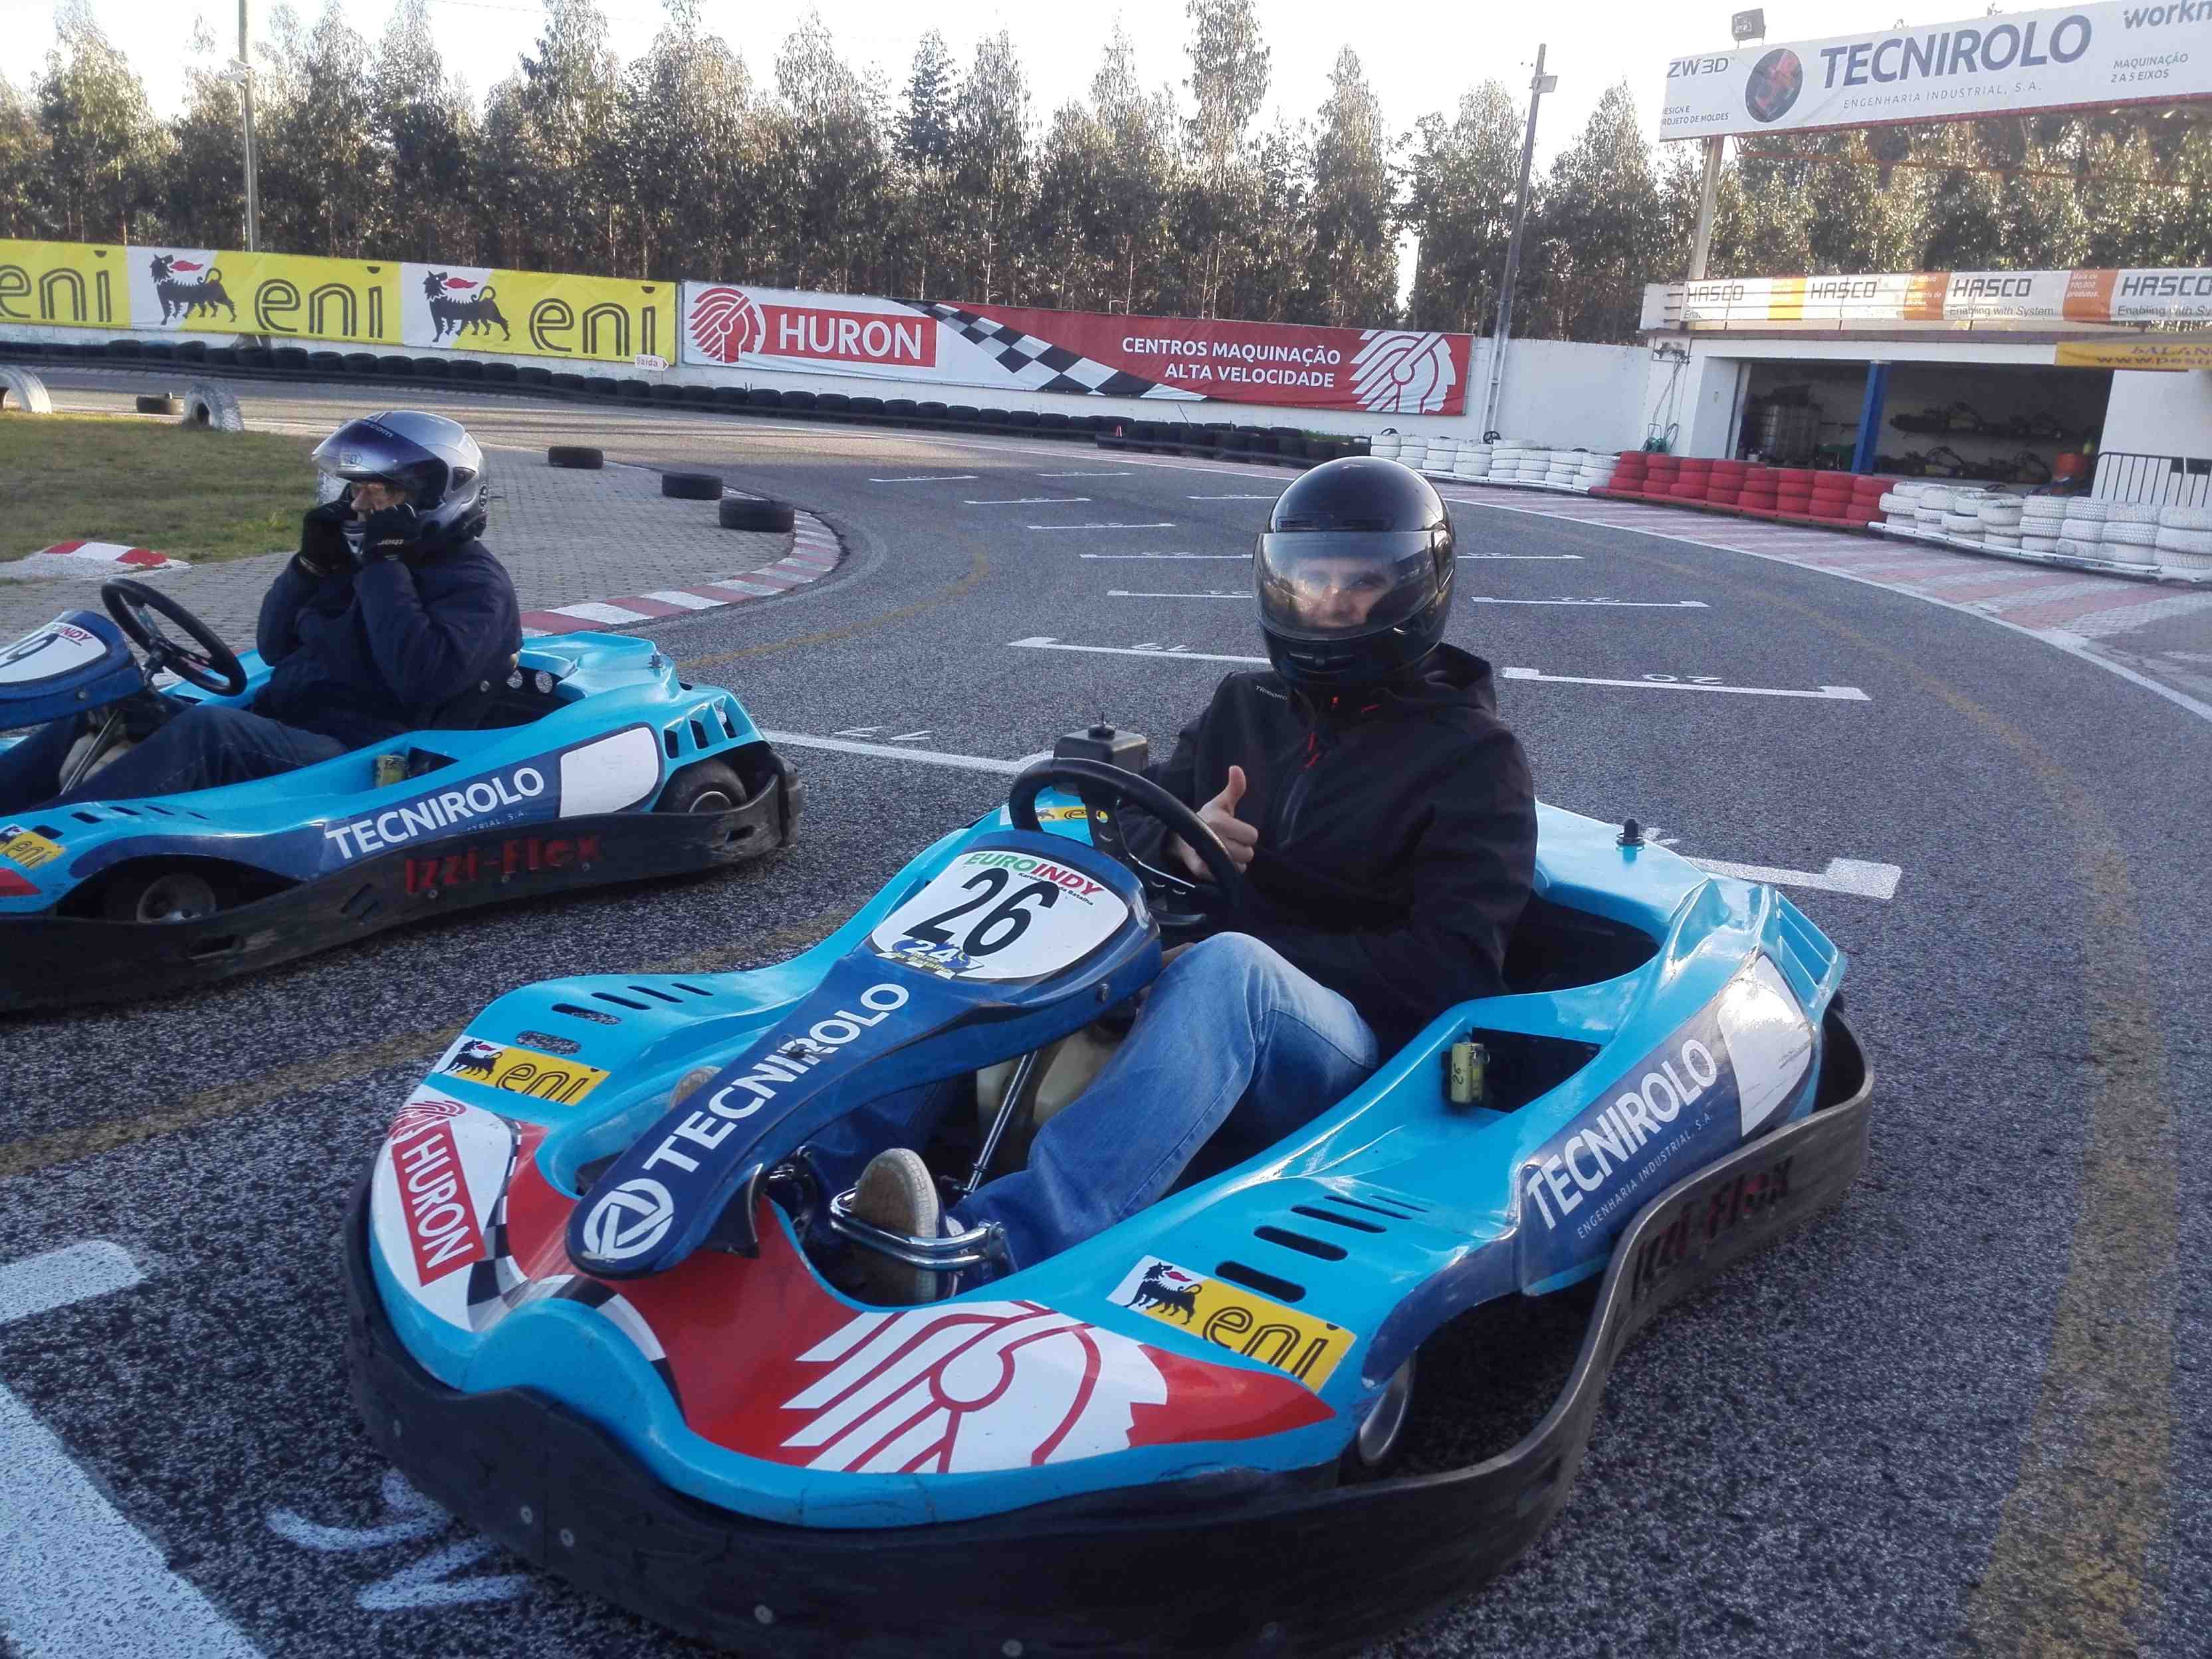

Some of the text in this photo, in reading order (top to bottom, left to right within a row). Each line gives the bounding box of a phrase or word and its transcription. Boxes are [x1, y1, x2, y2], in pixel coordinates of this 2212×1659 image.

[1820, 14, 2092, 89] TECNIROLO
[2118, 72, 2127, 82] A
[2137, 68, 2170, 80] EIXOS
[1690, 115, 1700, 124] DE
[1701, 112, 1729, 122] MOLDES
[1843, 80, 2043, 109] ENGENHARIA INDUSTRIAL, S.A.
[0, 250, 112, 323] eni
[255, 265, 384, 339] eni
[1811, 281, 1878, 299] HASCO
[1953, 278, 2033, 298] HASCO
[2120, 276, 2212, 296] HASCO
[529, 286, 656, 357] eni
[1949, 304, 1991, 316] Enabling
[1993, 306, 2013, 316] with
[2118, 304, 2166, 317] Enabling
[778, 313, 923, 360] HURON
[1122, 336, 1341, 367] CENTROS MAQUINAÇÃO
[1164, 363, 1335, 388] ALTA VELOCIDADE
[324, 767, 545, 859] TECNIROLO
[902, 867, 1061, 957] 26
[495, 1063, 600, 1103] eni
[641, 983, 910, 1173] TECNIROLO
[1526, 1039, 1717, 1230] TECNIROLO
[1577, 1111, 1714, 1240] ENGENHARIA INDUSTRIAL, S.A.
[401, 1132, 475, 1269] HURON
[1201, 1306, 1340, 1381] eni
